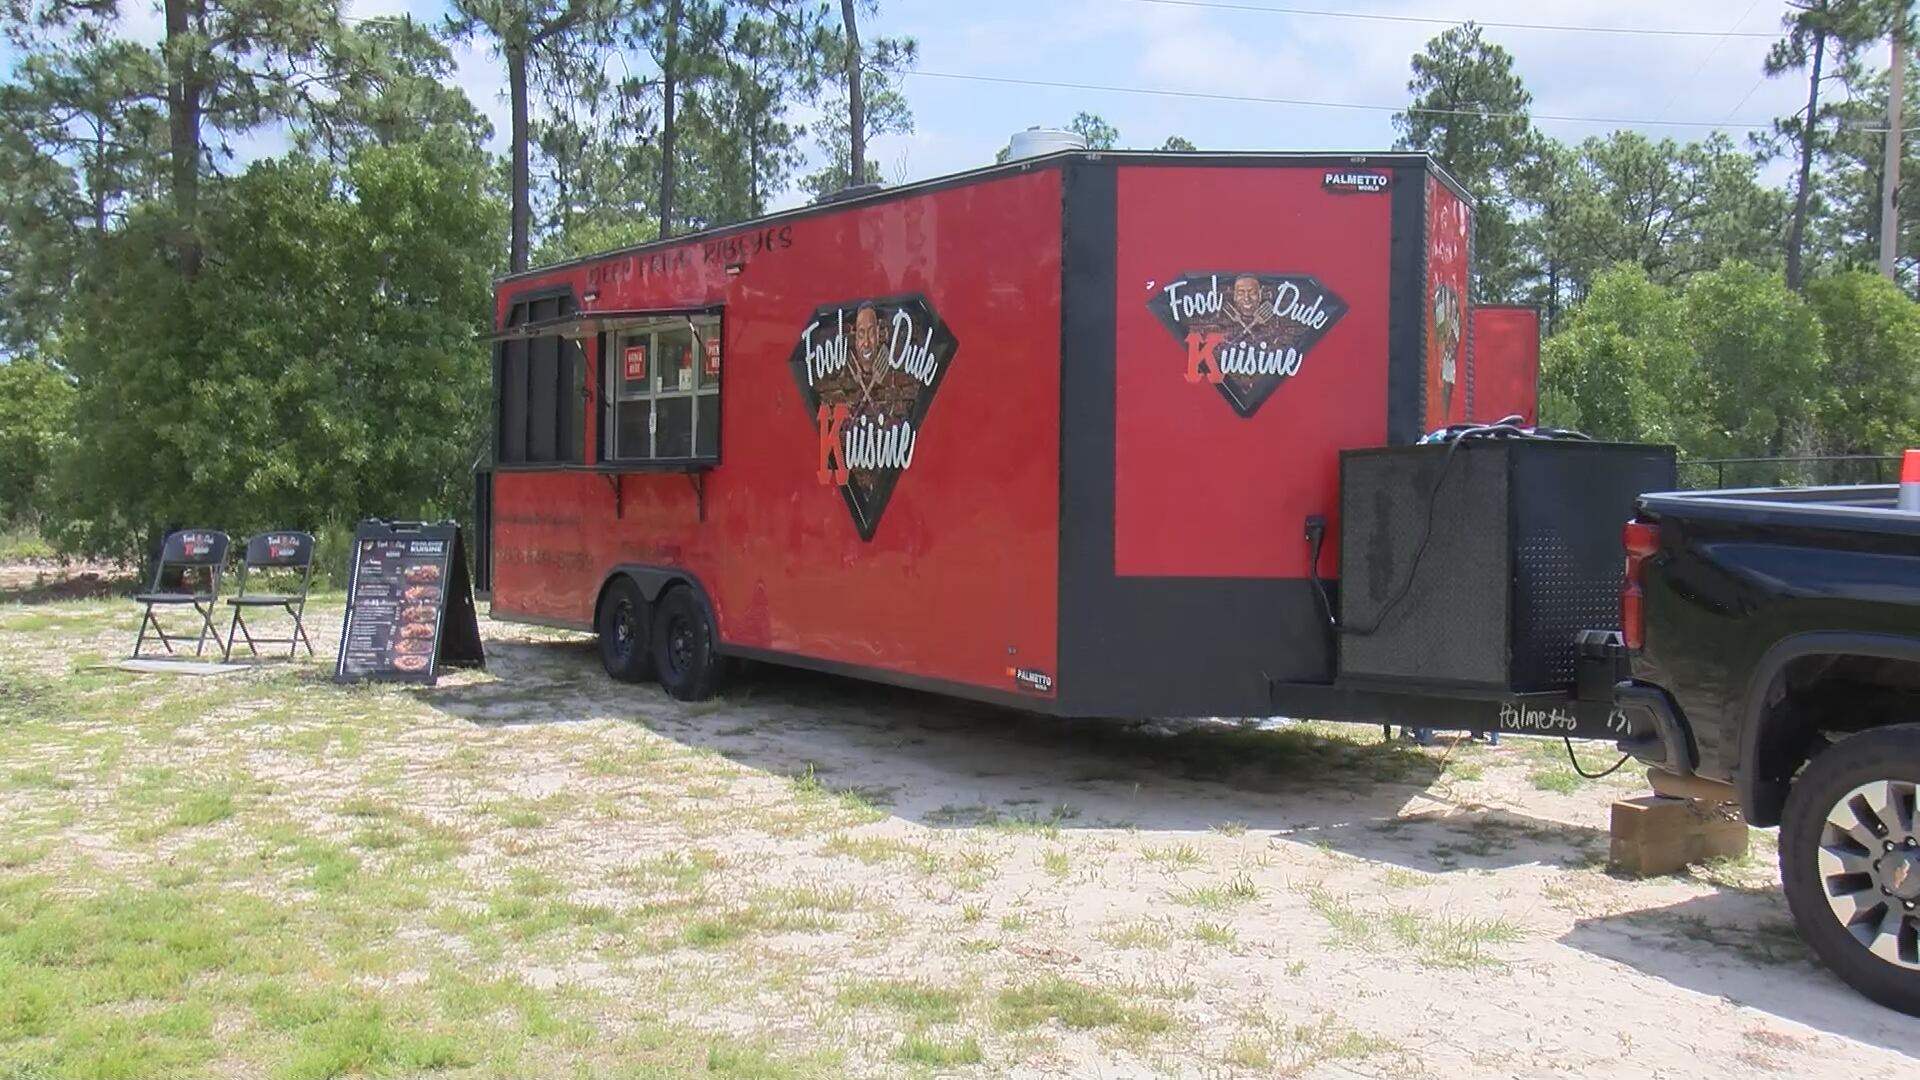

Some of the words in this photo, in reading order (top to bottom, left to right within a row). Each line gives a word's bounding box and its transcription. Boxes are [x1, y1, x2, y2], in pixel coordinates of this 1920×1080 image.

[1325, 173, 1388, 186] PALMETTO
[1164, 275, 1223, 321] Food
[1273, 281, 1328, 330] Dude
[802, 308, 848, 386] Food
[889, 308, 938, 387] Dude
[1184, 331, 1303, 384] Kuisine
[817, 402, 916, 486] Kuisine
[1017, 669, 1052, 687] PALMETTO
[1499, 703, 1578, 731] Palmetto
